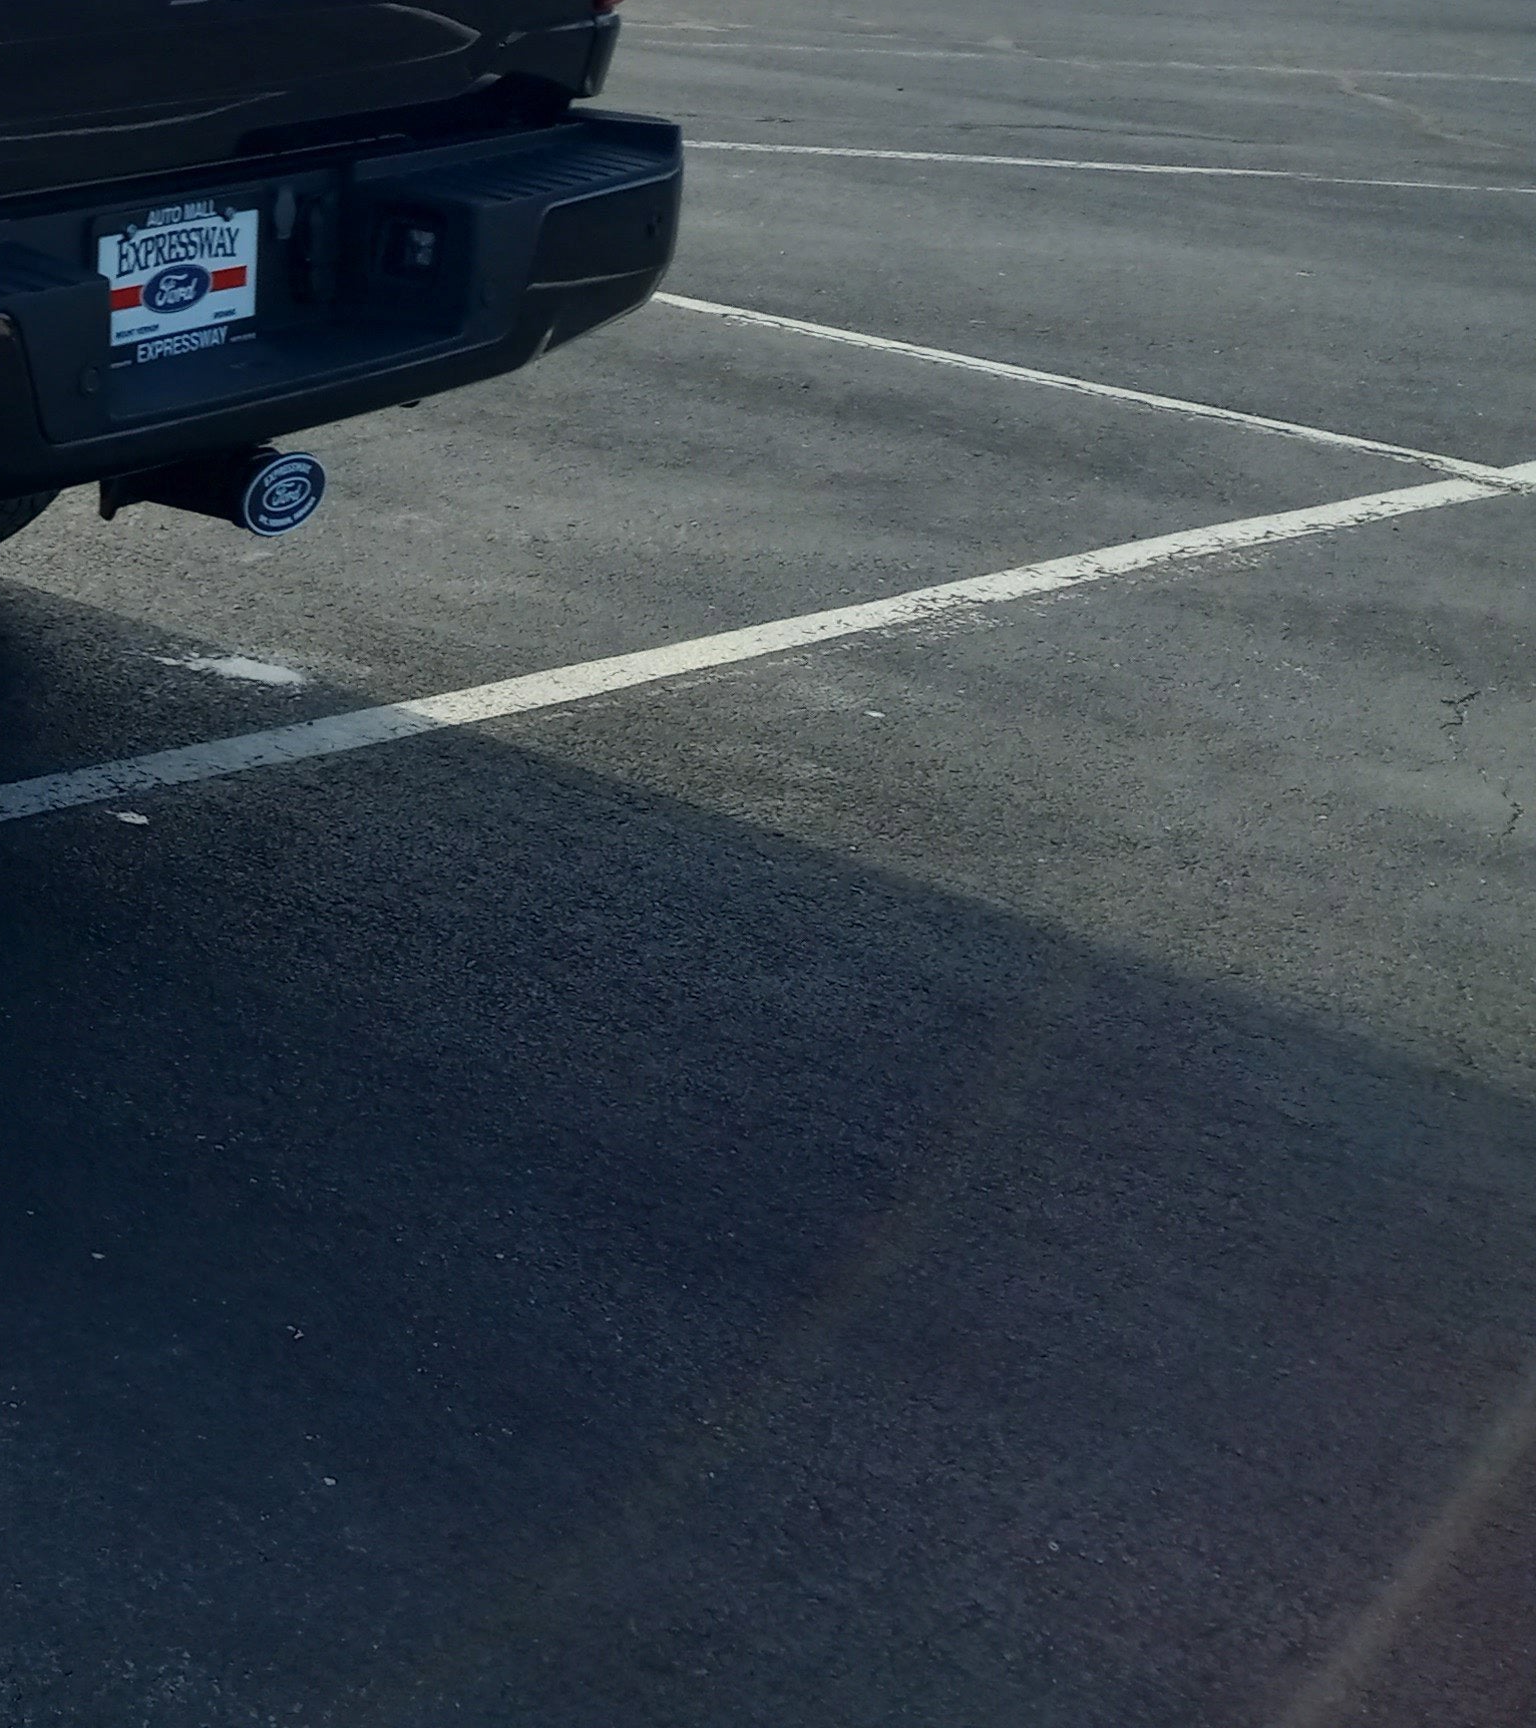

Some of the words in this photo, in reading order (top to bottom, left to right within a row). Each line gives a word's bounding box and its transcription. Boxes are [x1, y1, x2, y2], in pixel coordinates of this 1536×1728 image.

[147, 206, 182, 227] AUTO
[184, 200, 217, 221] MALL
[116, 226, 240, 278] EXPRESSWAY
[155, 274, 198, 307] Ford
[137, 325, 229, 364] EXPRESSWAY
